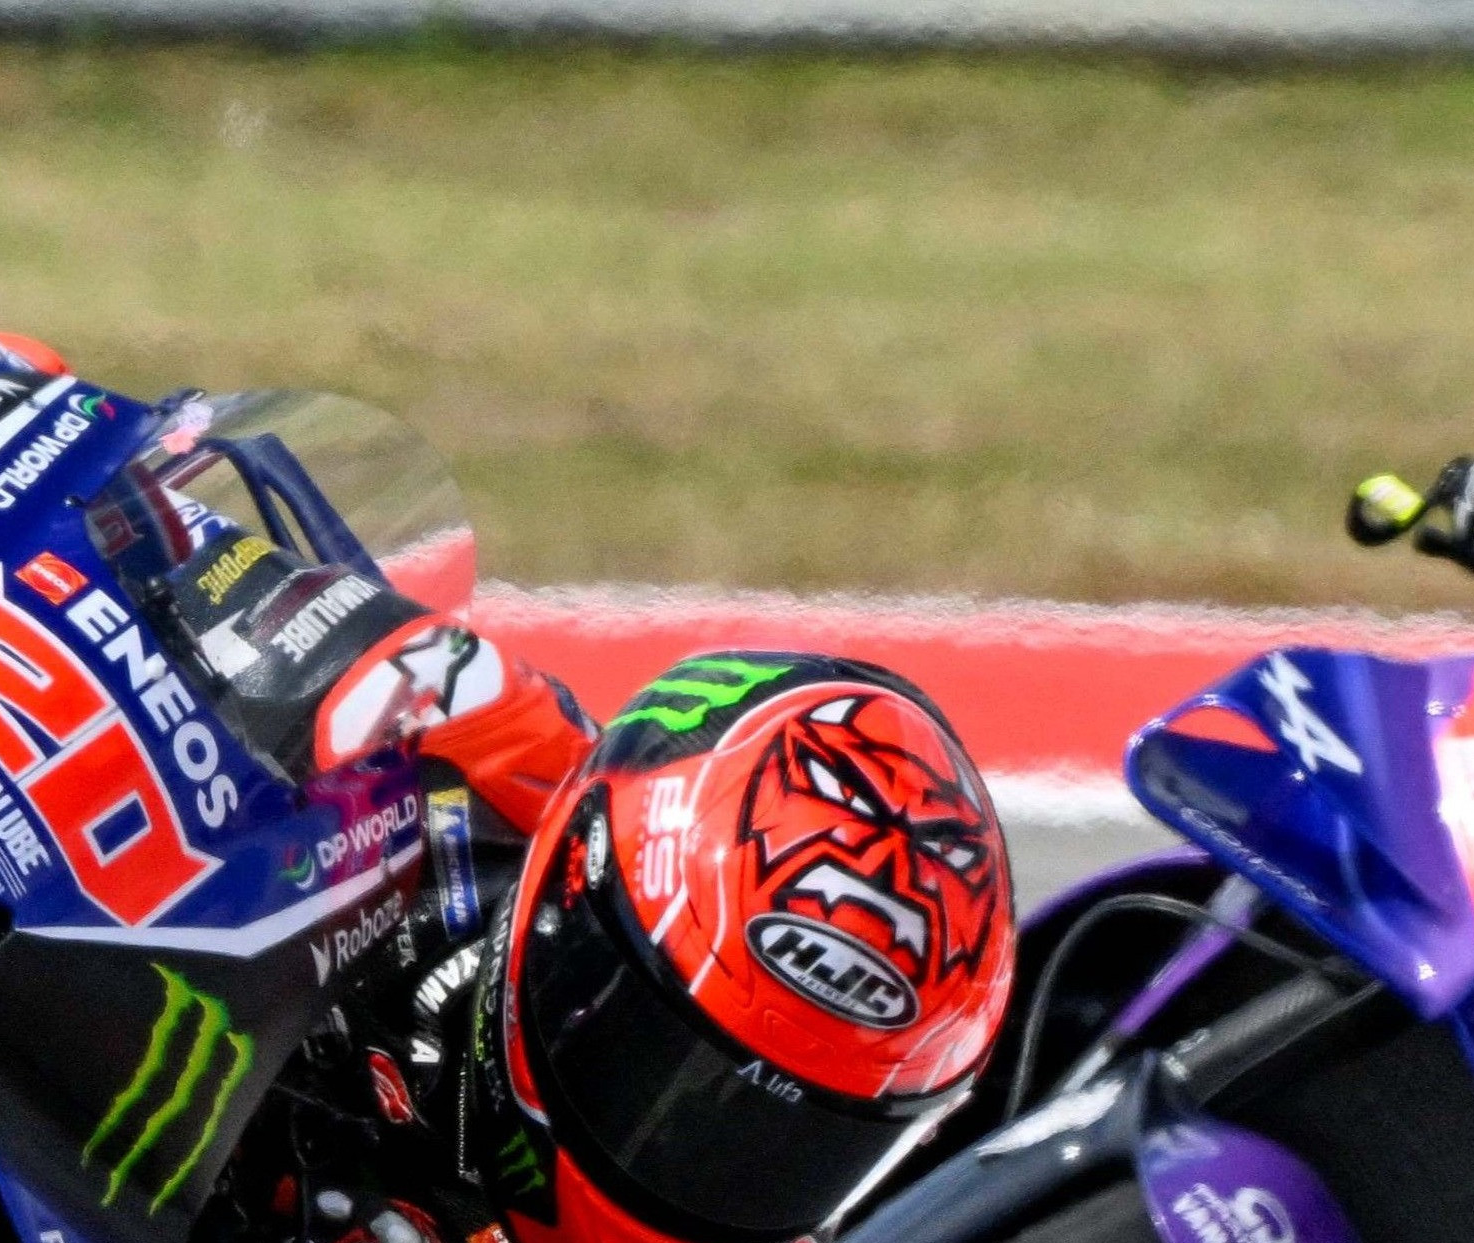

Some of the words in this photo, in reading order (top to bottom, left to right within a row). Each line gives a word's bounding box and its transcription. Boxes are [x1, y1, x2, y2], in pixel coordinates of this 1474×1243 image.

[65, 586, 239, 830] ENEOS
[315, 836, 350, 869] DP
[347, 794, 419, 853] WORLD
[763, 927, 906, 1017] HJC
